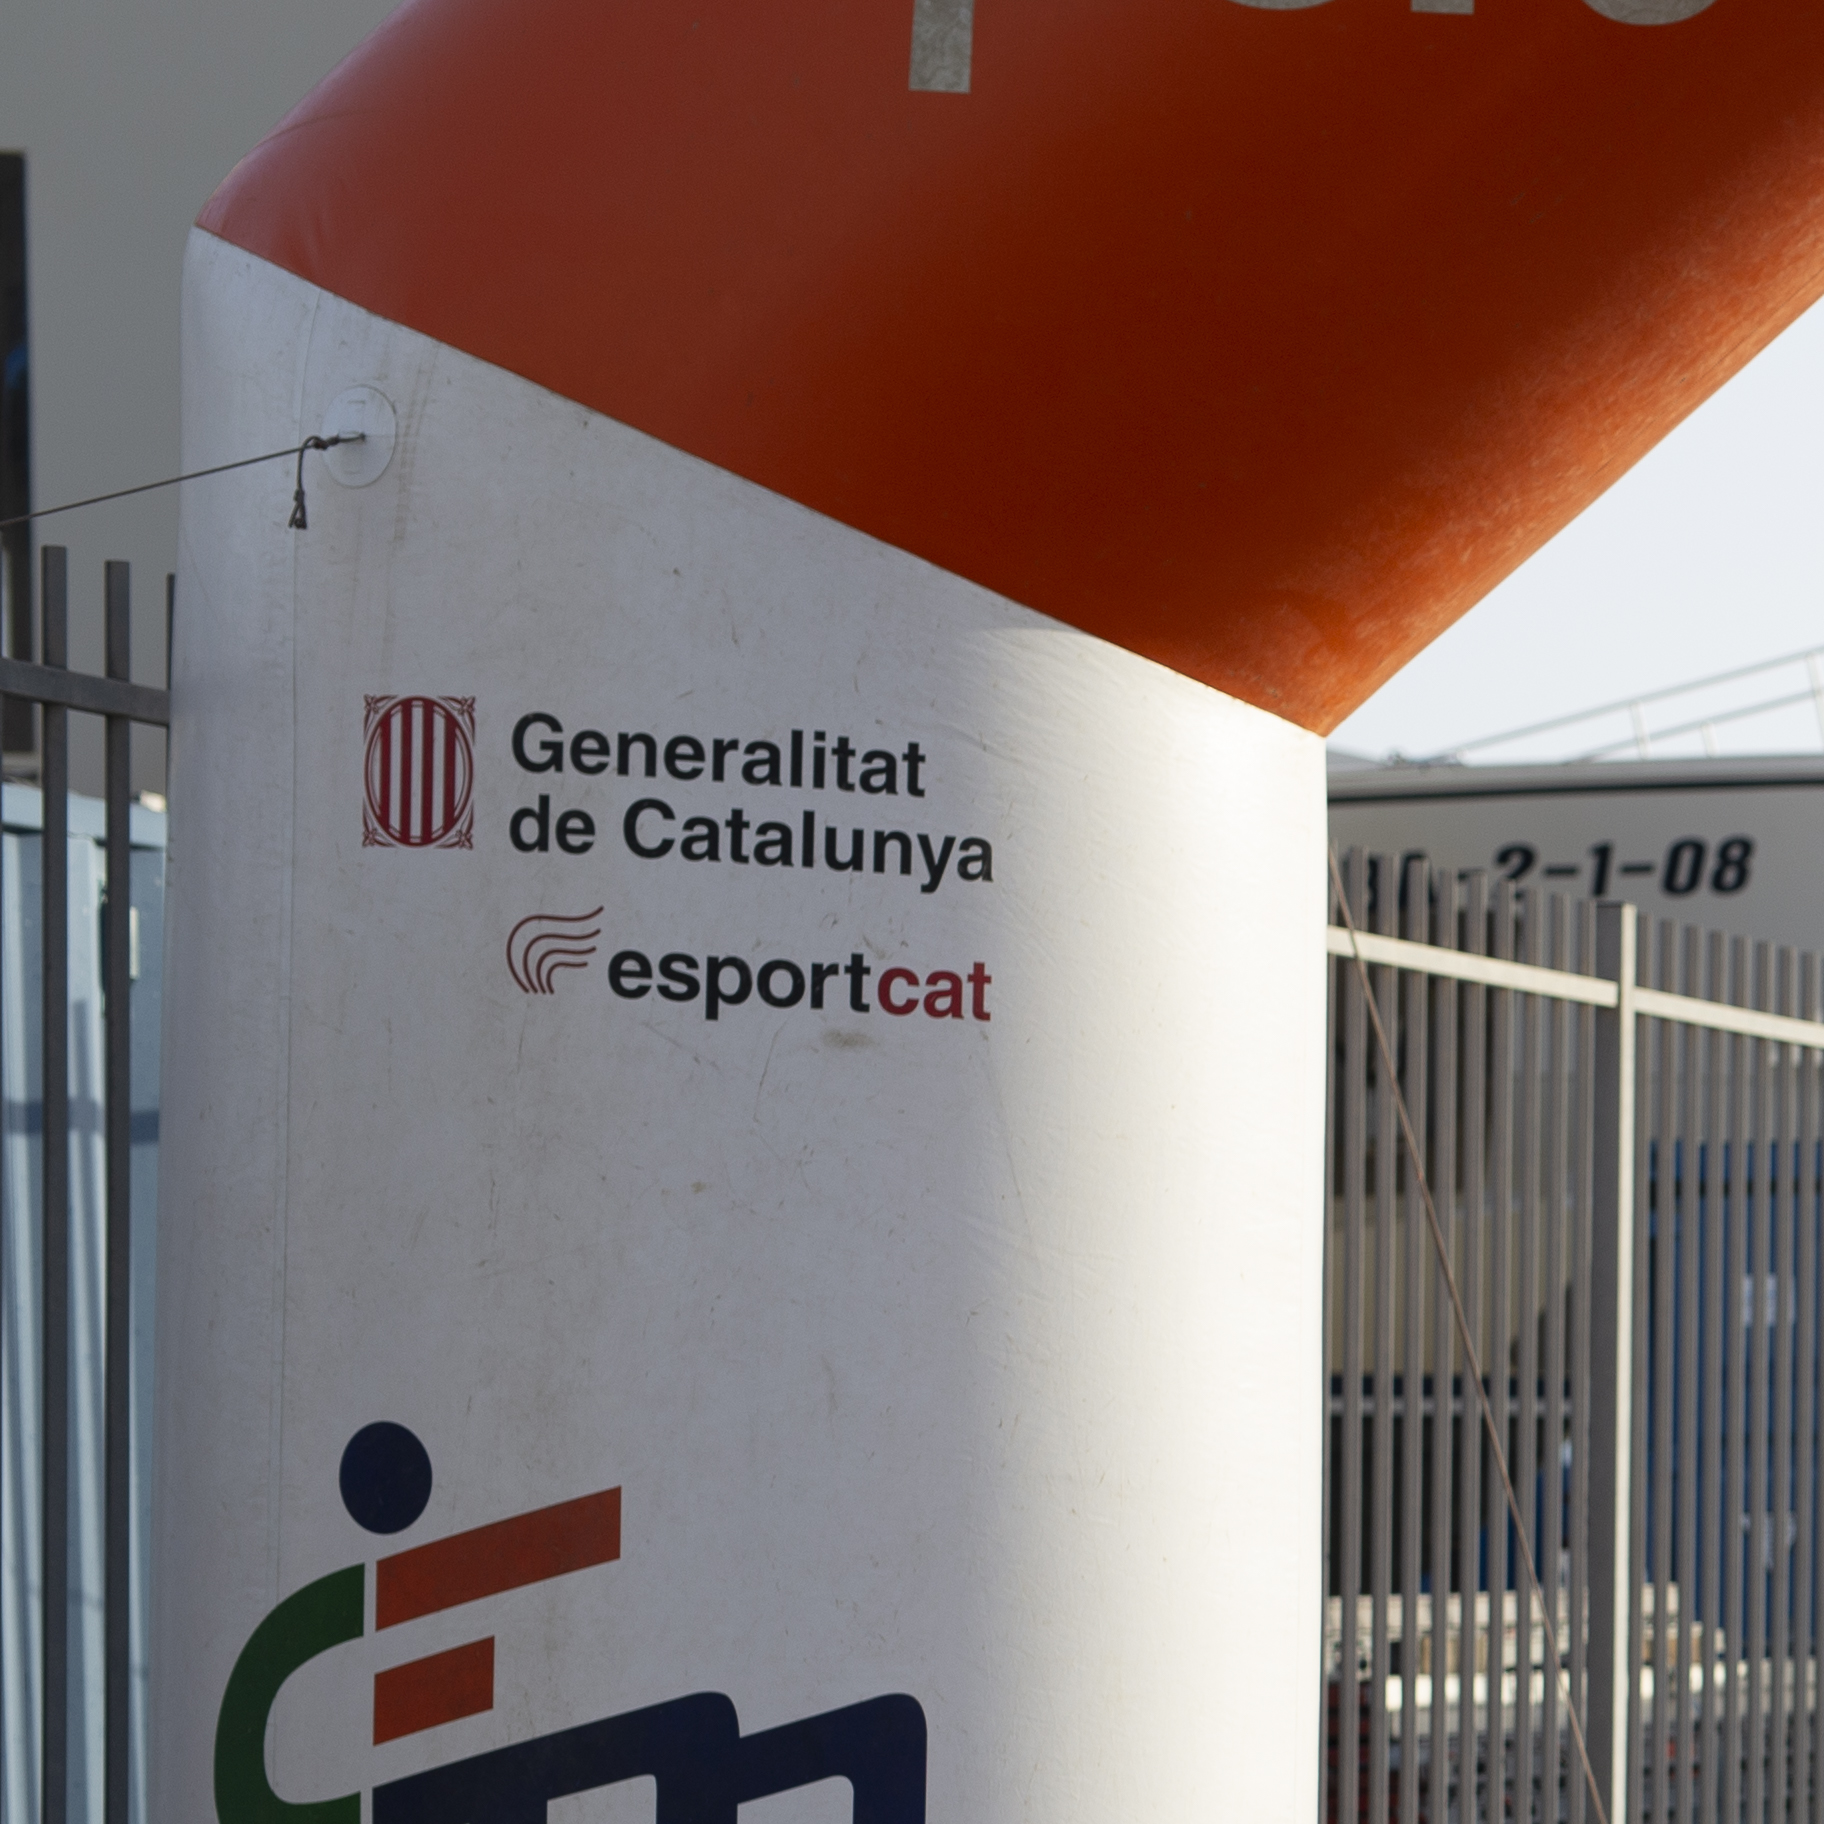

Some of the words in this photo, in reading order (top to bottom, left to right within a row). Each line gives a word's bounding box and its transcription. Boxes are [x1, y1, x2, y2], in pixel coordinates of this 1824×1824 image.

[511, 711, 926, 797] Generalitat
[508, 794, 596, 855] de
[622, 798, 994, 894] Catalunya
[607, 948, 992, 1021] esportcat
